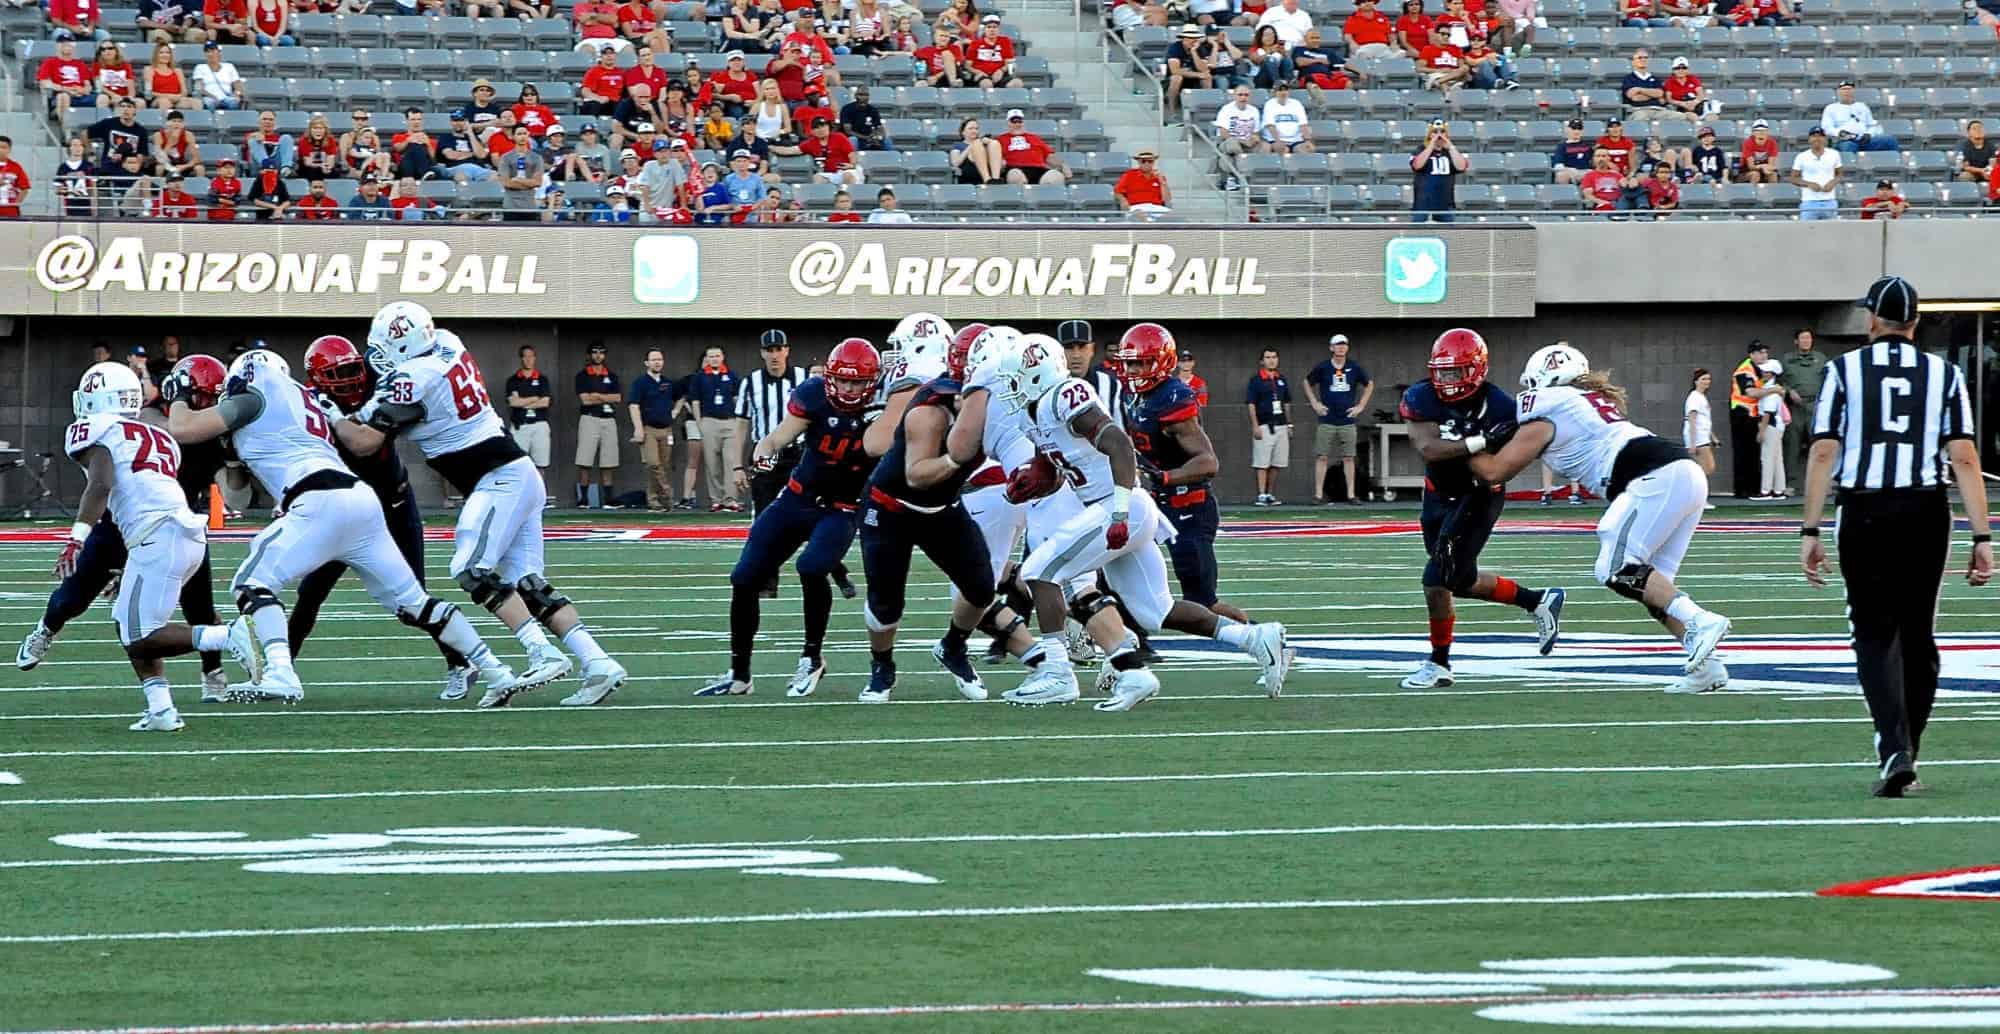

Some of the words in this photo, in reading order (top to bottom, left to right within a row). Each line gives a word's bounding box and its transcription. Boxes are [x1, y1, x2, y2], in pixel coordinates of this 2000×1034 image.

[1700, 156, 1717, 172] 14
[445, 351, 490, 420] 63
[1062, 383, 1090, 410] 23
[1881, 376, 1911, 434] C
[70, 422, 90, 445] 25
[122, 421, 177, 479] 25
